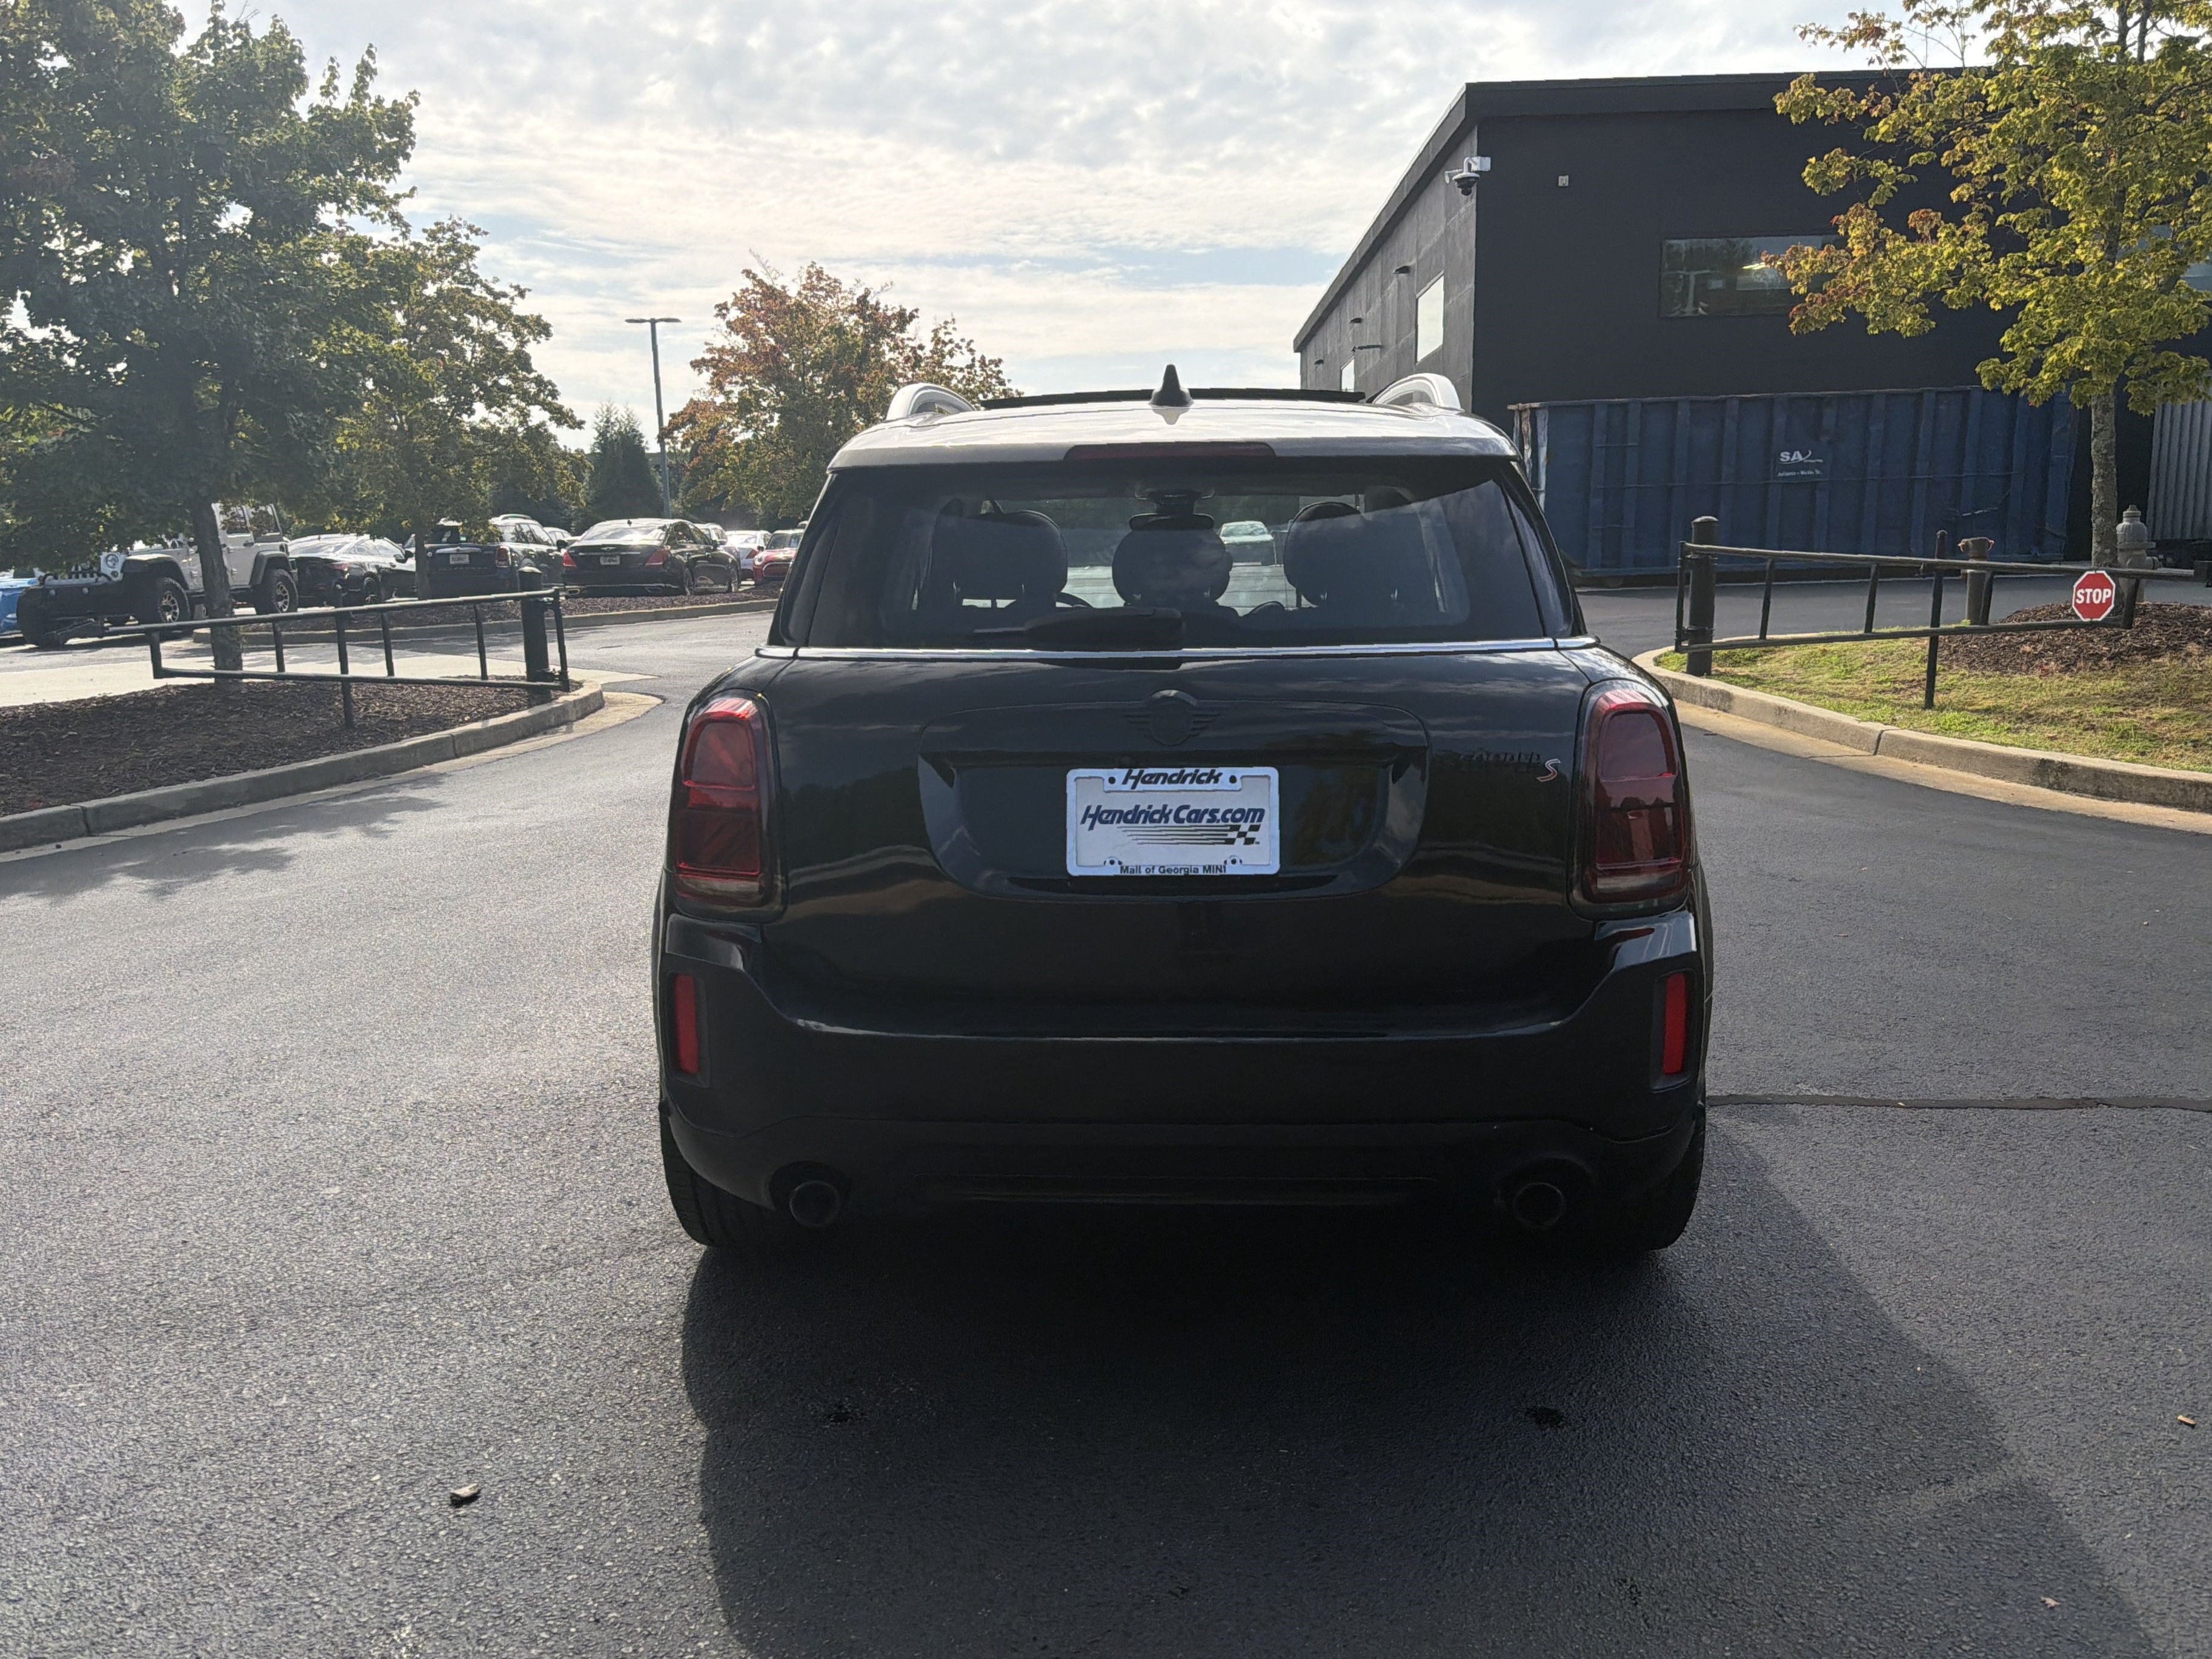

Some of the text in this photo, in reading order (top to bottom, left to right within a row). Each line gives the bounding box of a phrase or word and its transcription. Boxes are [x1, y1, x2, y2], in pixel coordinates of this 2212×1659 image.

[2075, 588, 2112, 604] STOP
[1121, 769, 1223, 790] Hendrick
[1080, 804, 1265, 831] HendrickCars.com
[1120, 865, 1226, 876] Mall of Georgia MINI
